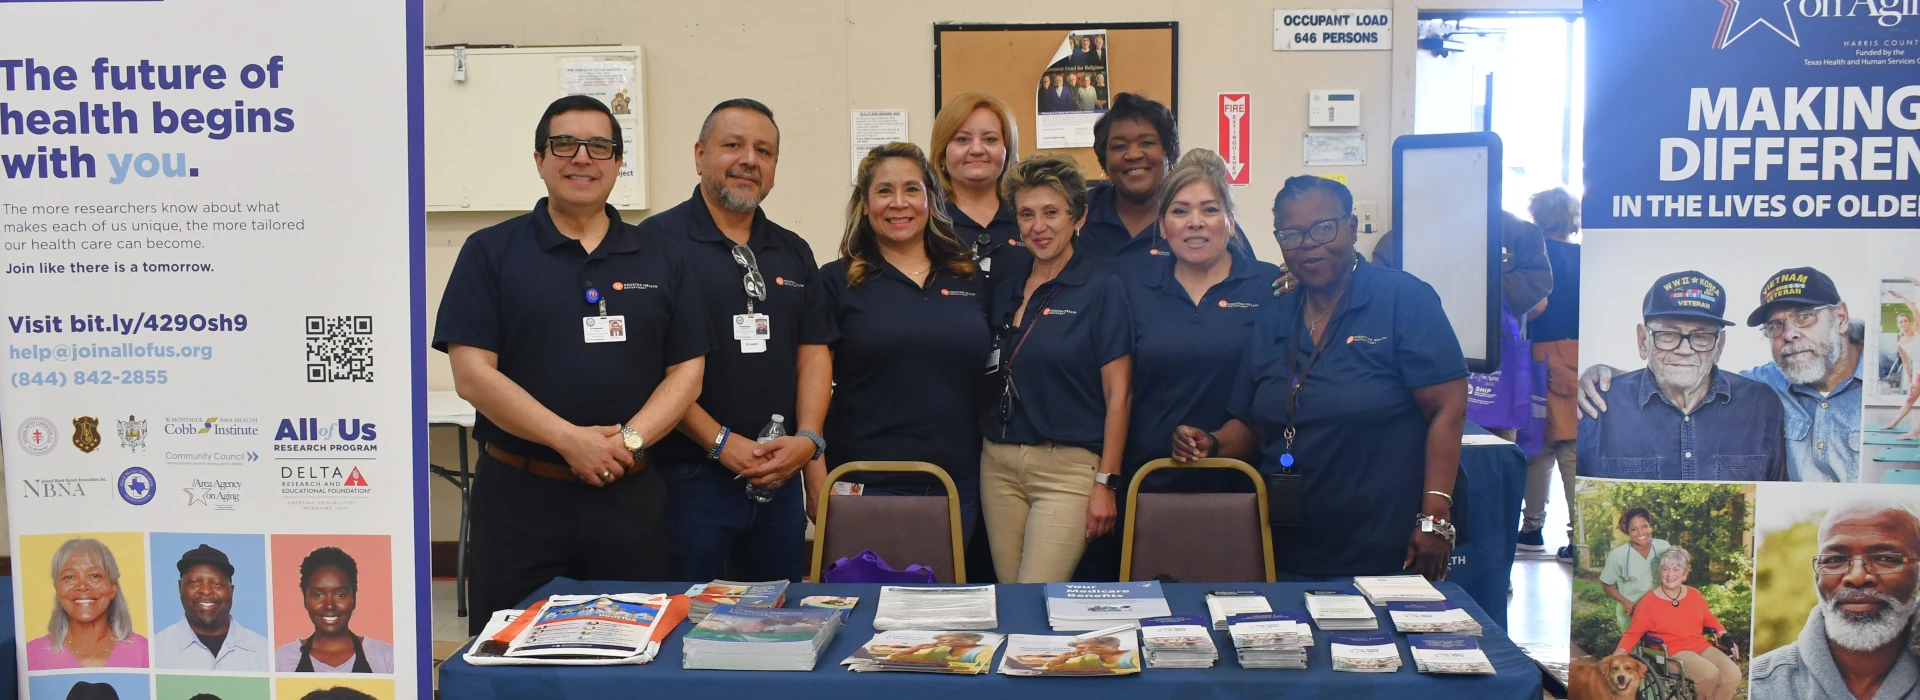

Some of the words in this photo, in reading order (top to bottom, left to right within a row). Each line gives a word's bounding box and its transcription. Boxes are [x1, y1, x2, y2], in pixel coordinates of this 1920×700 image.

[1283, 15, 1350, 26] OCCUPANT
[1356, 15, 1388, 26] LOAD
[1294, 32, 1317, 44] 646
[1322, 32, 1378, 44] PERSONS
[1883, 49, 1892, 57] by
[1888, 57, 1915, 65] Services
[0, 58, 78, 91] The
[92, 57, 227, 91] future
[240, 55, 284, 89] of
[1225, 104, 1245, 113] FIRE
[1687, 85, 1920, 131] MAKING
[0, 101, 138, 135] health
[152, 100, 295, 140] begins
[1, 145, 96, 179] with
[107, 152, 199, 185] you.
[3, 204, 28, 215] The
[32, 205, 70, 215] more
[74, 202, 158, 214] researchers
[161, 202, 198, 213] know
[202, 201, 242, 213] about
[246, 201, 280, 213] what
[1612, 195, 1642, 217] IN
[1646, 195, 1702, 217] THE
[1708, 194, 1787, 218] LIVES
[1792, 194, 1832, 218] OF
[1837, 194, 1920, 218] OLDE
[4, 221, 48, 233] makes
[52, 220, 87, 232] each
[91, 220, 107, 232] of
[111, 222, 127, 232] us
[131, 220, 182, 234] unique,
[186, 219, 209, 231] the
[212, 221, 248, 231] more
[251, 218, 305, 231] tailored
[4, 241, 27, 251] our
[31, 238, 76, 251] health
[81, 239, 112, 250] care
[117, 240, 142, 250] can
[146, 238, 205, 250] become.
[6, 262, 34, 275] Join
[40, 262, 65, 274] like
[70, 261, 110, 273] there
[114, 262, 126, 273] is
[130, 264, 138, 273] a
[142, 262, 214, 273] tomorrow.
[1699, 277, 1720, 297] KOREA
[1762, 272, 1808, 295] VIETNAM
[1767, 288, 1801, 303] VETERAN
[1677, 300, 1710, 309] VETERAN
[8, 315, 62, 334] Visit
[9, 343, 213, 362] help@joinallofus.org
[11, 371, 68, 389] (844)
[73, 369, 168, 385] 842-2855
[1475, 386, 1492, 394] SHIP
[164, 423, 197, 435] Cobb
[213, 423, 259, 435] Institute
[274, 417, 318, 441] All
[318, 422, 338, 441] of
[338, 418, 377, 441] Us
[274, 444, 327, 452] RESEARCH
[330, 444, 378, 452] PROGRAM
[165, 451, 212, 461] Community
[213, 452, 245, 460] Council
[281, 466, 343, 479] DELTA
[23, 479, 86, 498] NBNA
[194, 479, 212, 488] Area
[213, 479, 243, 491] Agency
[216, 491, 240, 502] Aging
